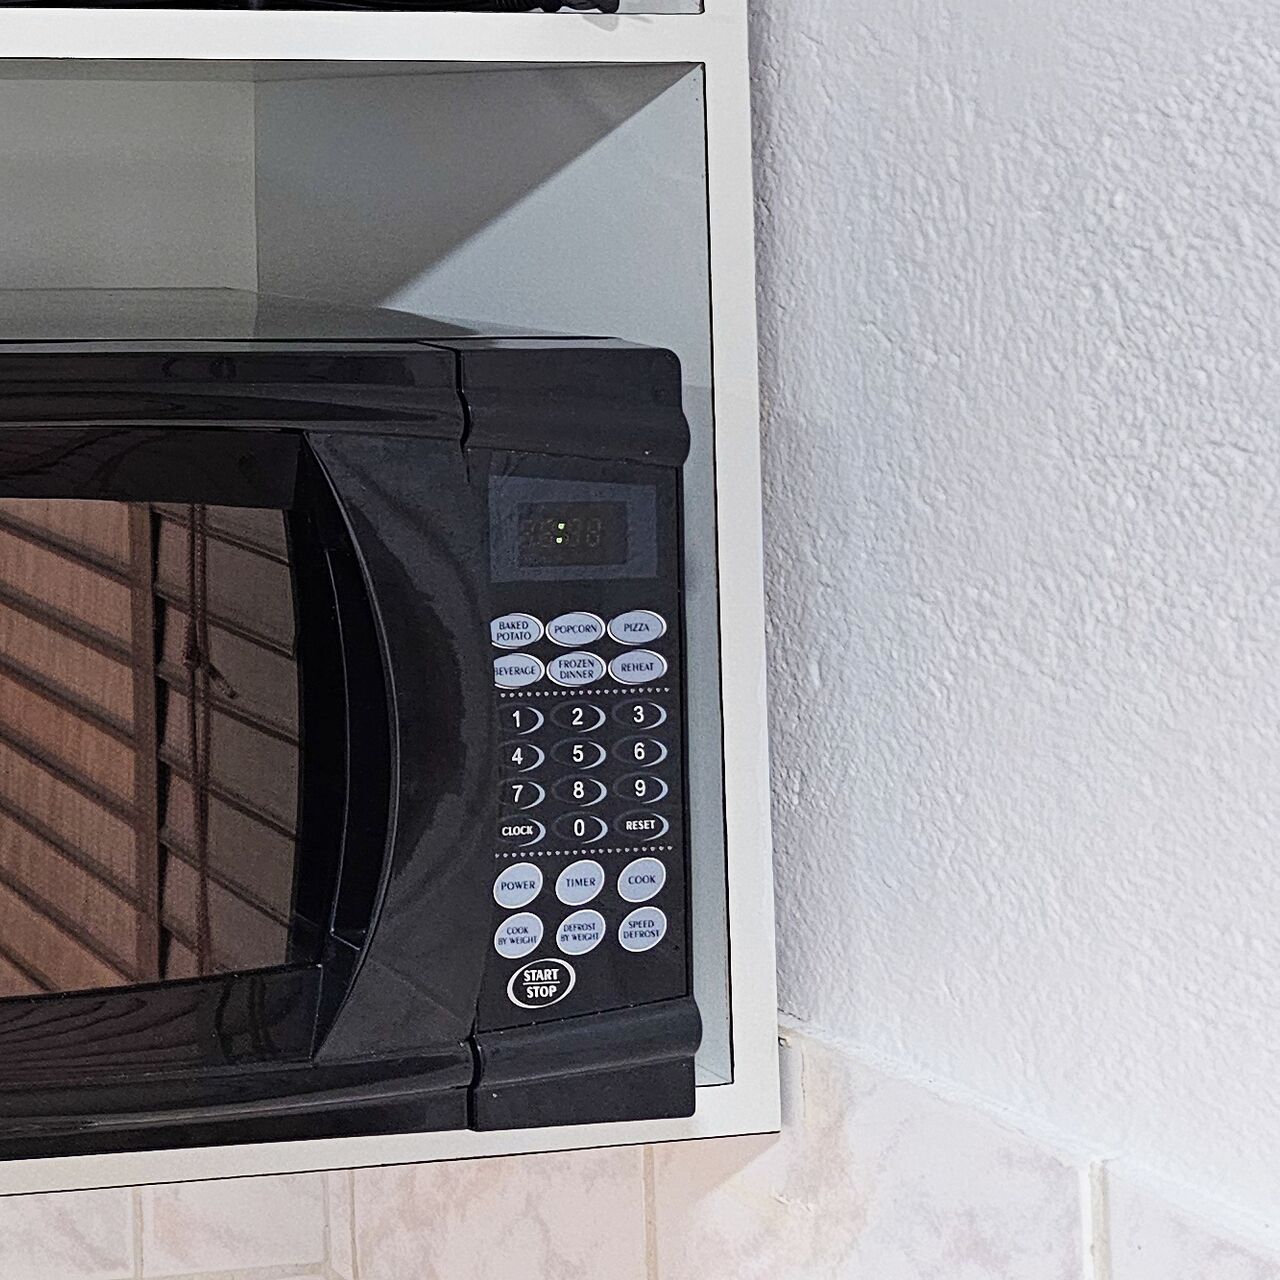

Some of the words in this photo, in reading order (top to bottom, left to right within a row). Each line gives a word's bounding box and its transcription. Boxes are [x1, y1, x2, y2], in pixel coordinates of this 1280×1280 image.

[499, 621, 528, 630] BAKED
[555, 625, 597, 633] POPCORN
[624, 623, 649, 632] PIZZA
[497, 632, 532, 641] POTATO
[559, 660, 594, 668] FROZEN
[621, 663, 654, 672] REHEAT
[560, 671, 594, 679] DINNER
[513, 711, 520, 727] 1
[572, 708, 583, 725] 2
[634, 706, 644, 722] 3
[573, 745, 583, 762] 5
[634, 742, 645, 759] 6
[512, 748, 523, 764] 4
[573, 781, 584, 798] 8
[635, 780, 645, 796] 9
[512, 785, 523, 802] 7
[574, 819, 584, 836] 0
[626, 820, 655, 830] RESET
[502, 826, 533, 836] CLOCK
[566, 878, 596, 887] TIMER
[628, 875, 656, 884] COOK
[501, 881, 535, 890] POWER
[564, 923, 596, 932] DEFROST
[628, 920, 654, 928] SPEED
[507, 926, 529, 935] COOK
[623, 929, 660, 939] DEFROST
[498, 937, 508, 945] BY
[509, 936, 537, 944] WEIGHT
[561, 933, 569, 942] BY
[571, 931, 599, 941] WEIGHT
[523, 968, 560, 981] START
[527, 985, 557, 998] STOP
